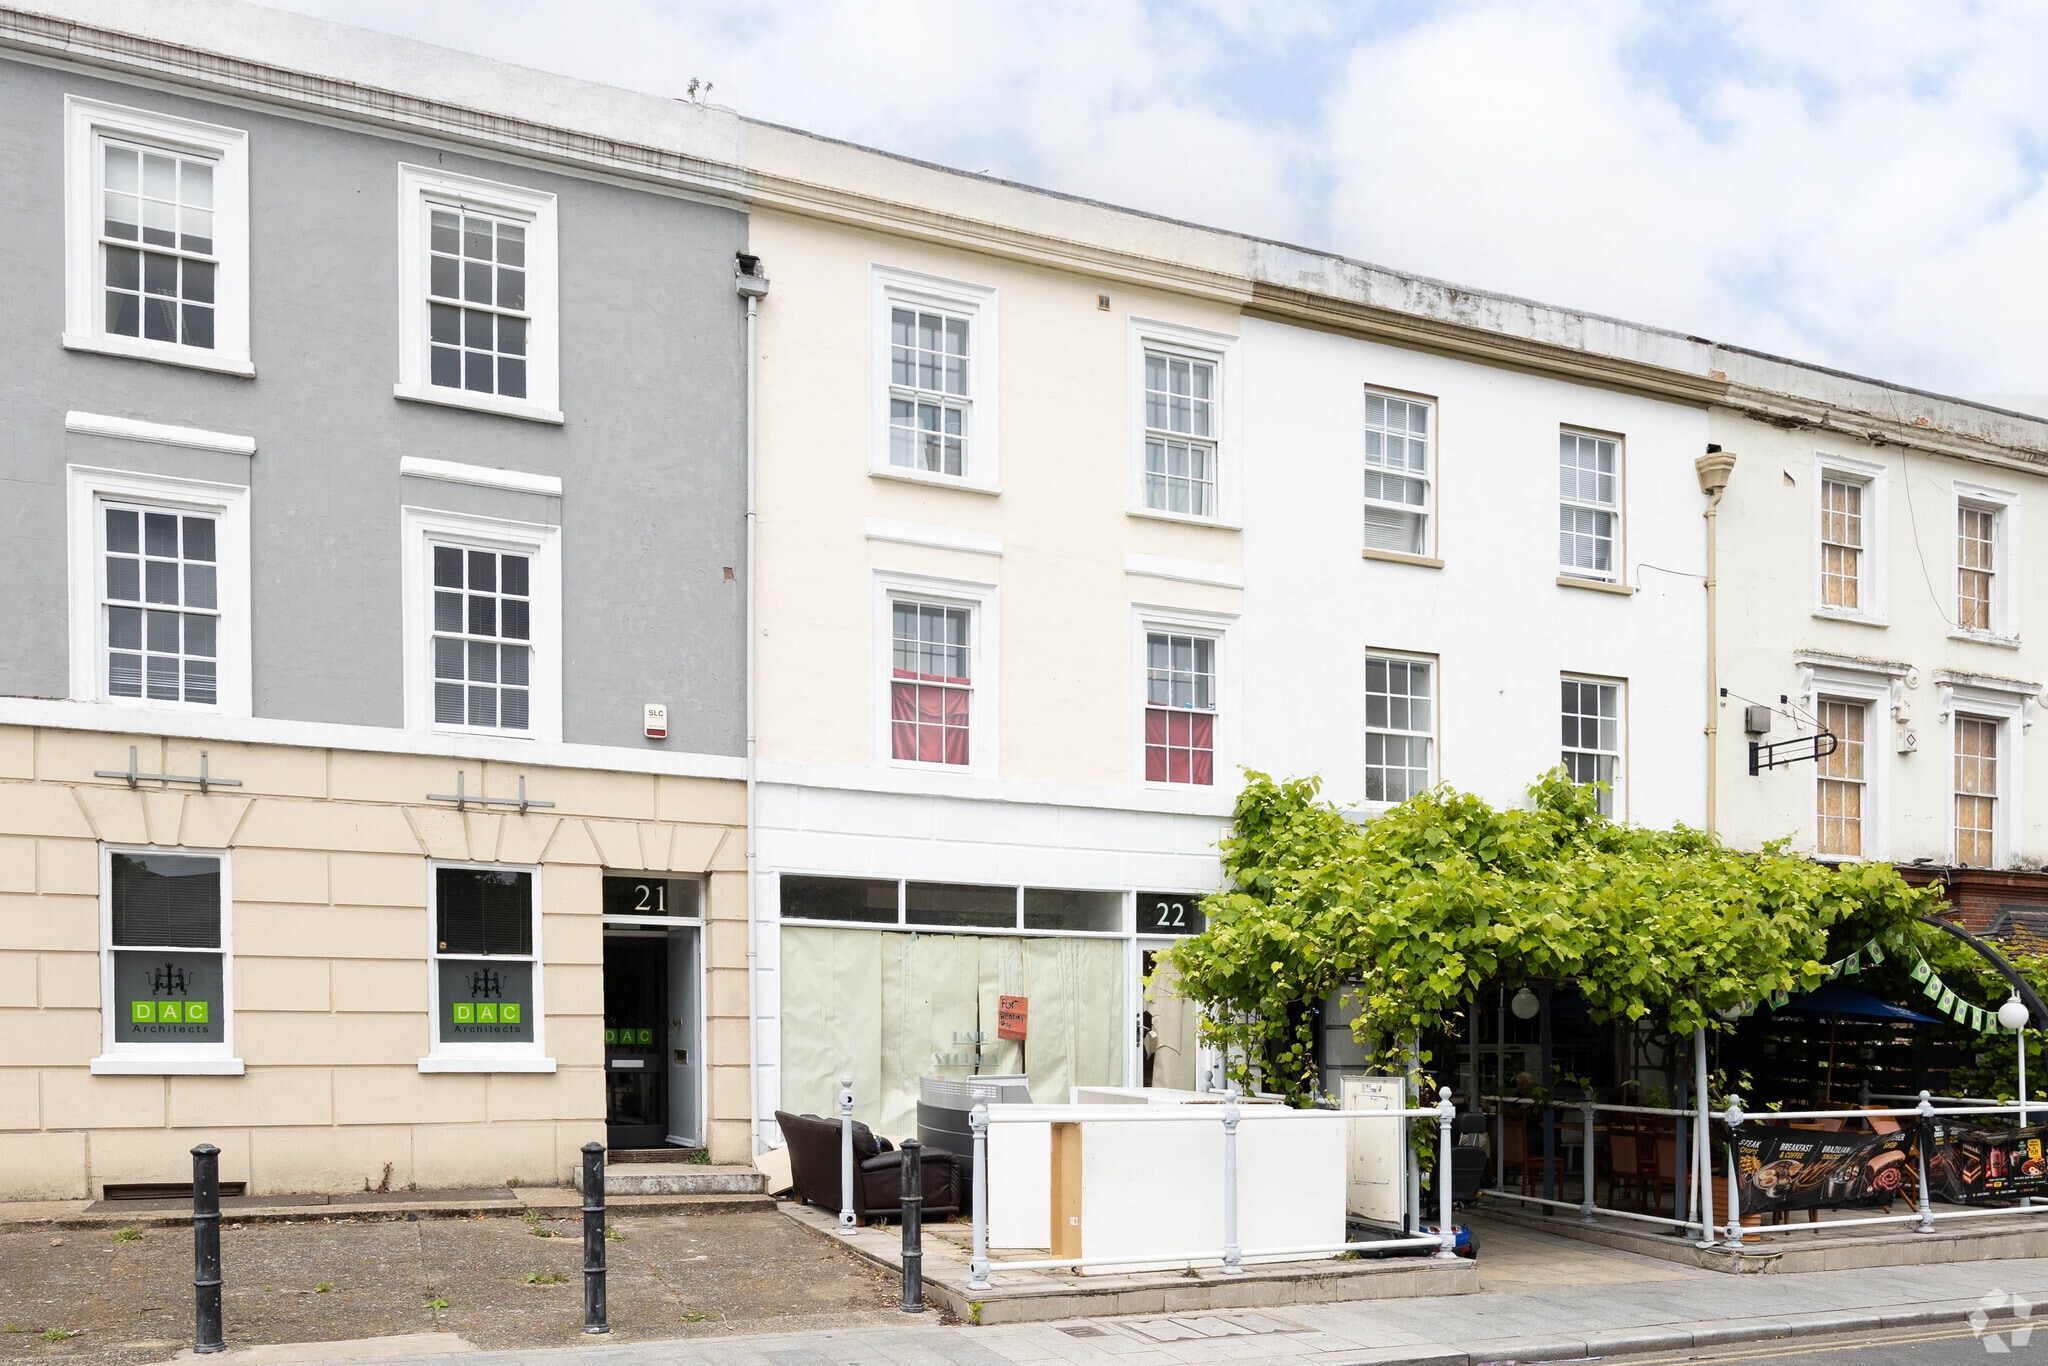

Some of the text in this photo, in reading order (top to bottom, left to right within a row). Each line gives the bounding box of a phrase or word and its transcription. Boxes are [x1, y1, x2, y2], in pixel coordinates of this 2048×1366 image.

[648, 709, 664, 717] SLC
[634, 885, 666, 911] 21
[1156, 902, 1185, 926] 22
[136, 1004, 203, 1019] DAC
[457, 1006, 516, 1020] DAC
[132, 1025, 208, 1033] Architects
[454, 1025, 520, 1033] Architects
[606, 1030, 649, 1042] DAC
[1739, 1139, 1761, 1148] STEAK
[1780, 1143, 1813, 1152] BREAKFAST
